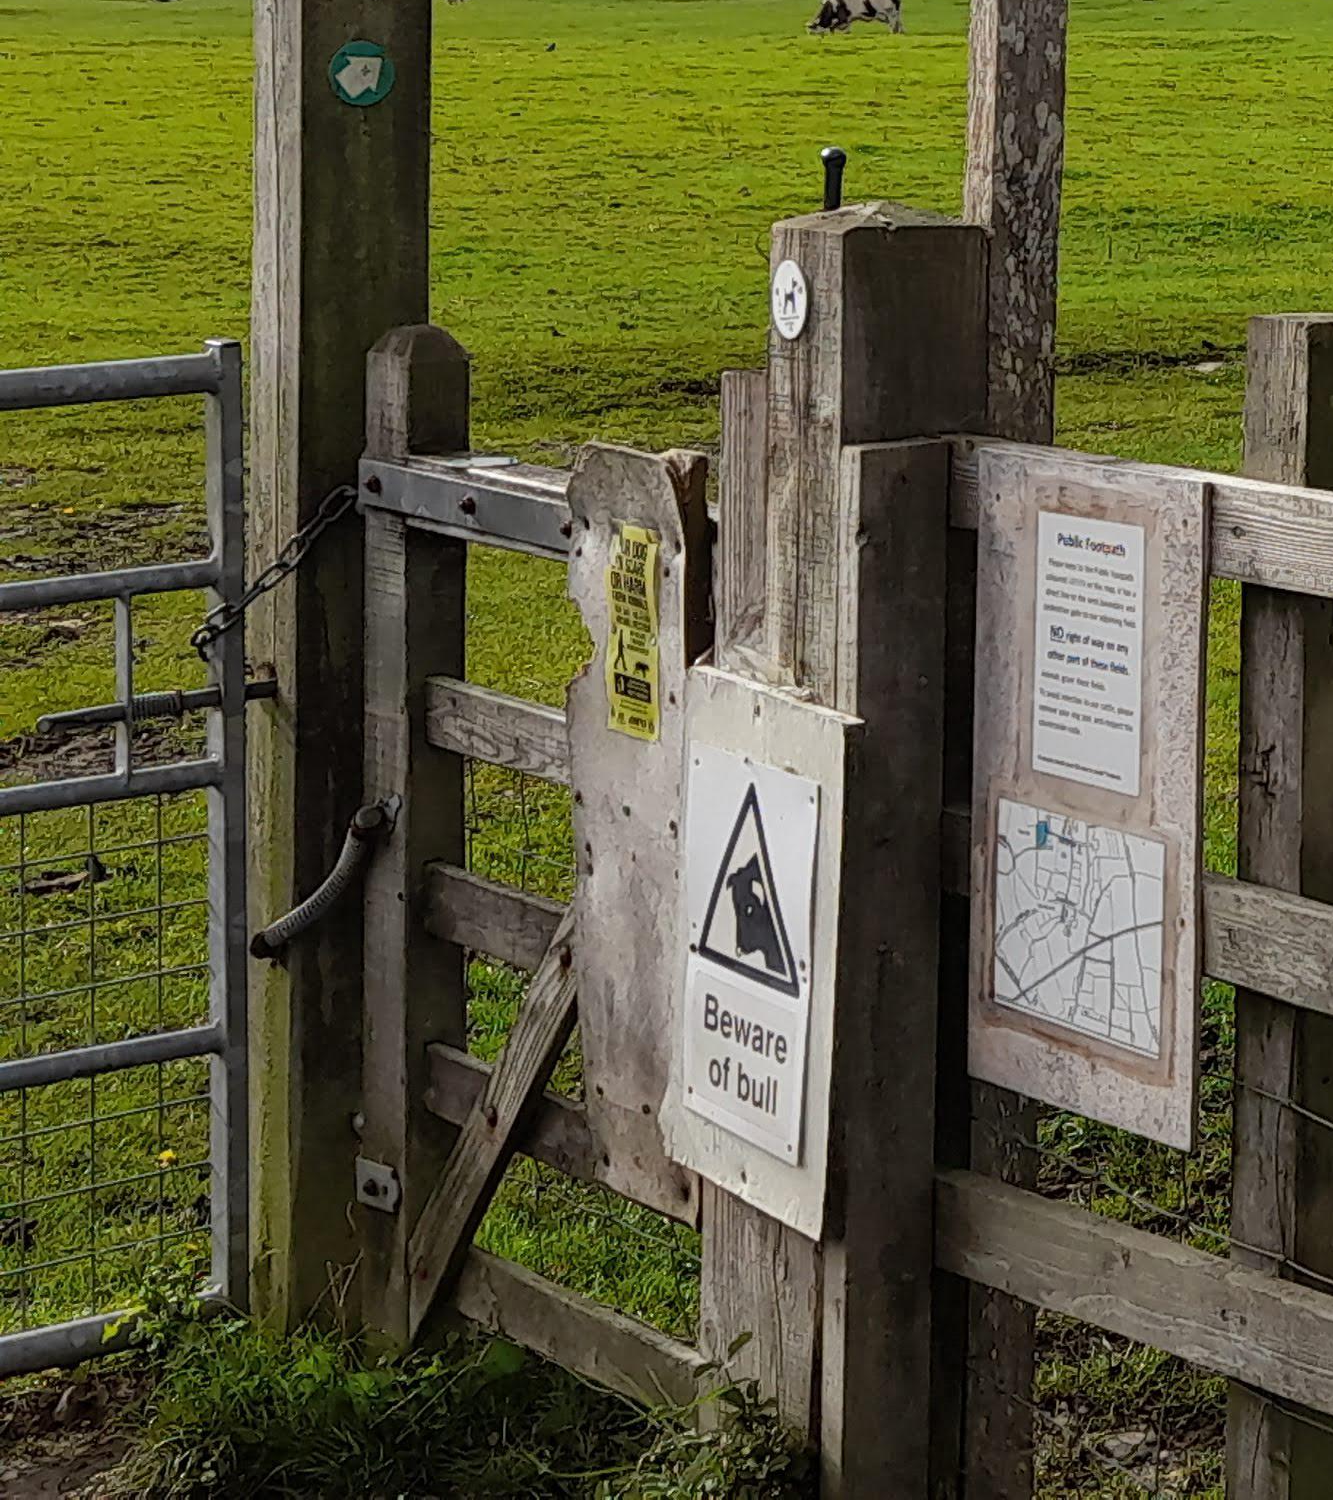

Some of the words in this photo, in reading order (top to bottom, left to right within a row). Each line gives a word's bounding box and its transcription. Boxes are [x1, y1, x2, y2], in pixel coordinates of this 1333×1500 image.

[1057, 533, 1083, 548] Public
[611, 571, 622, 590] OR
[1050, 625, 1065, 641] NO
[704, 992, 788, 1064] Beware
[709, 1056, 731, 1091] of
[737, 1062, 778, 1116] bull
